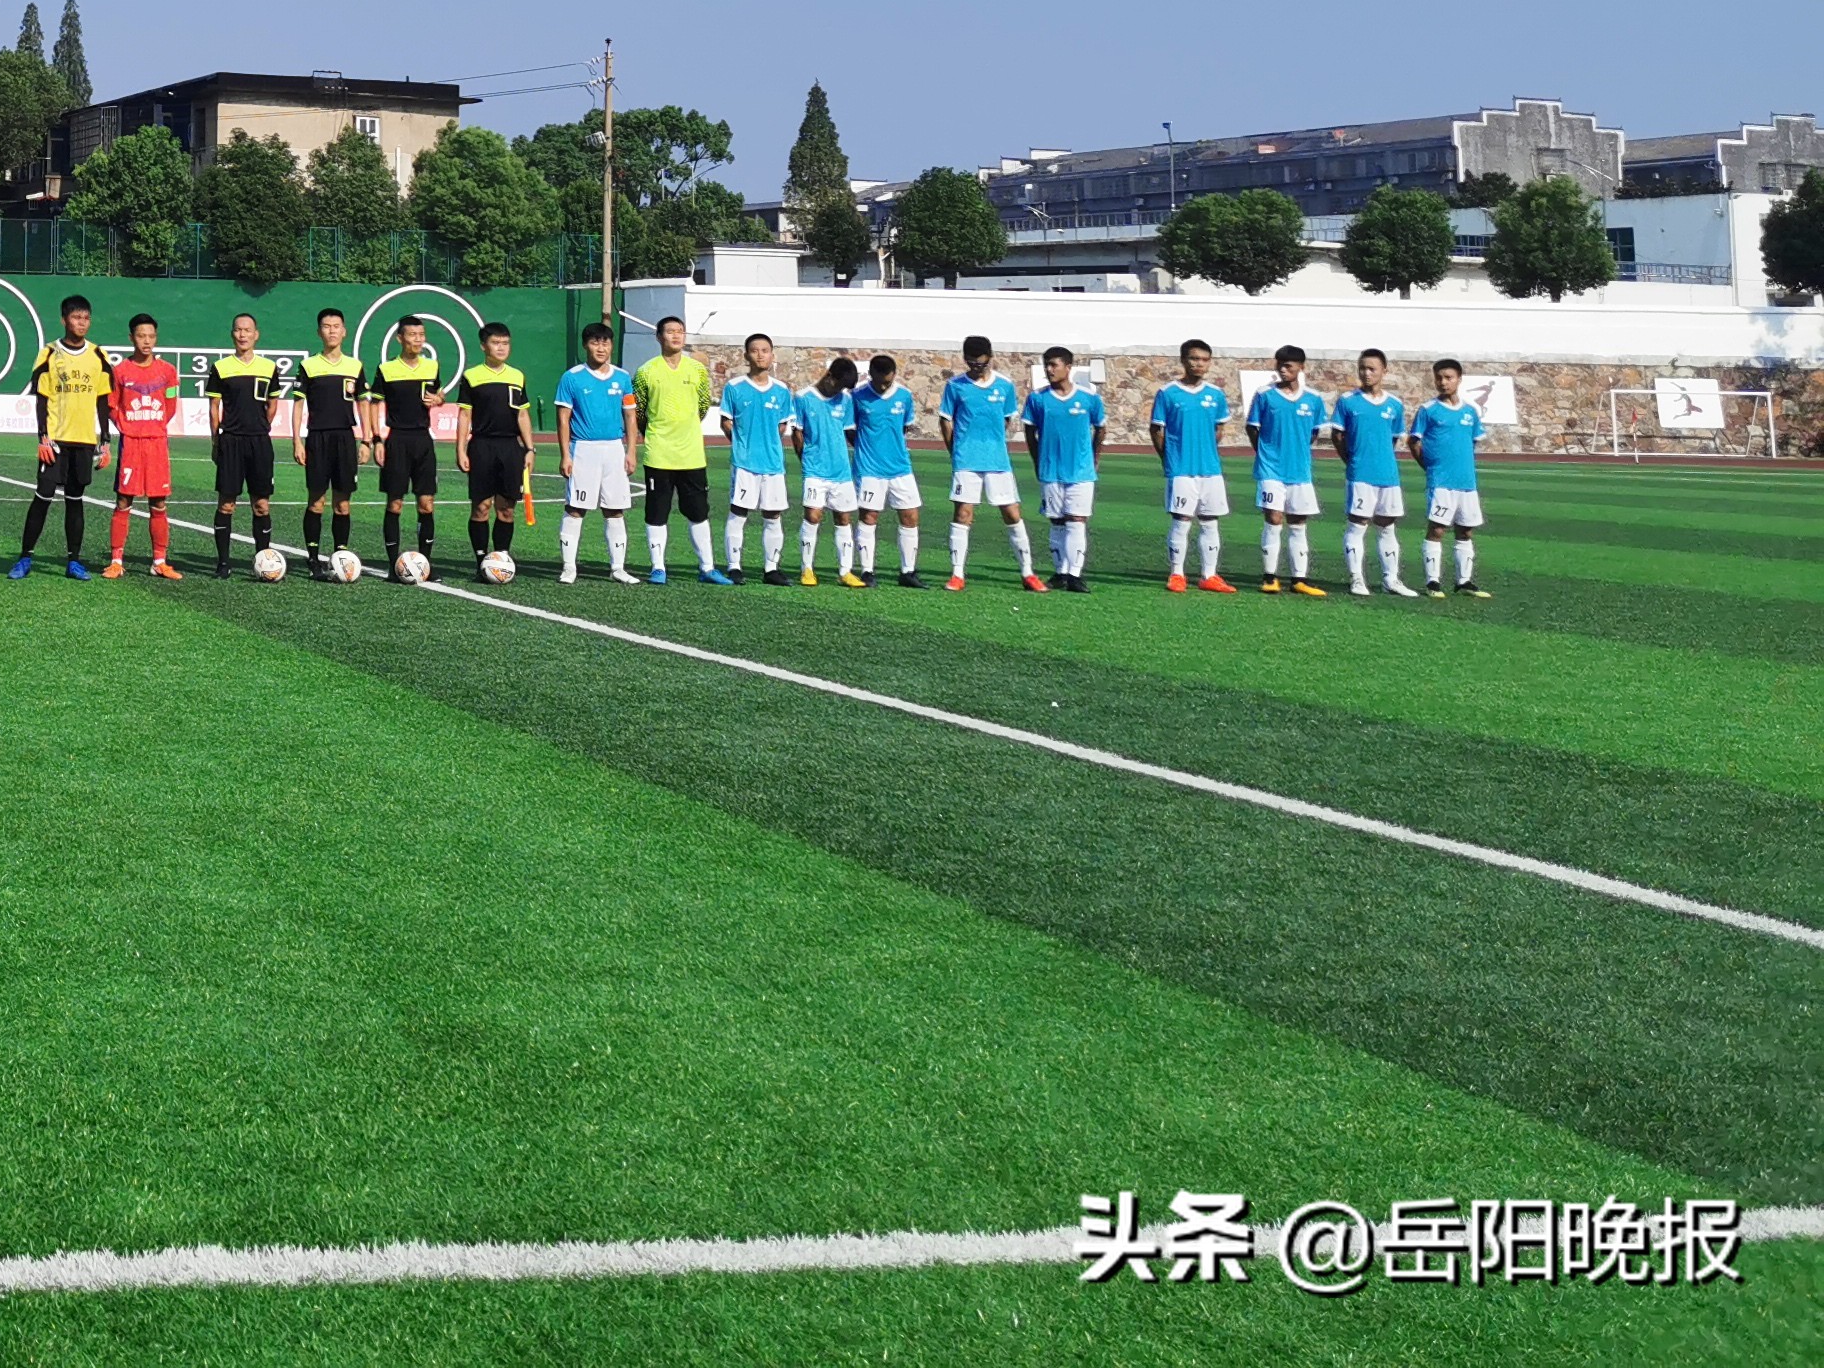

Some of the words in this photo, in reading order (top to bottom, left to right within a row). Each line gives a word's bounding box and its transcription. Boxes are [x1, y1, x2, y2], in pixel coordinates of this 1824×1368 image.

[192, 355, 208, 373] 3
[276, 357, 293, 375] 9
[194, 379, 206, 397] 1
[278, 381, 293, 399] 7
[123, 467, 133, 485] 7
[650, 478, 655, 491] 1
[576, 489, 587, 502] 10
[740, 489, 747, 500] 7
[863, 490, 875, 503] 17
[1261, 491, 1274, 504] 30
[1176, 496, 1188, 508] 19
[1356, 497, 1364, 510] 2
[1431, 505, 1449, 518] 27
